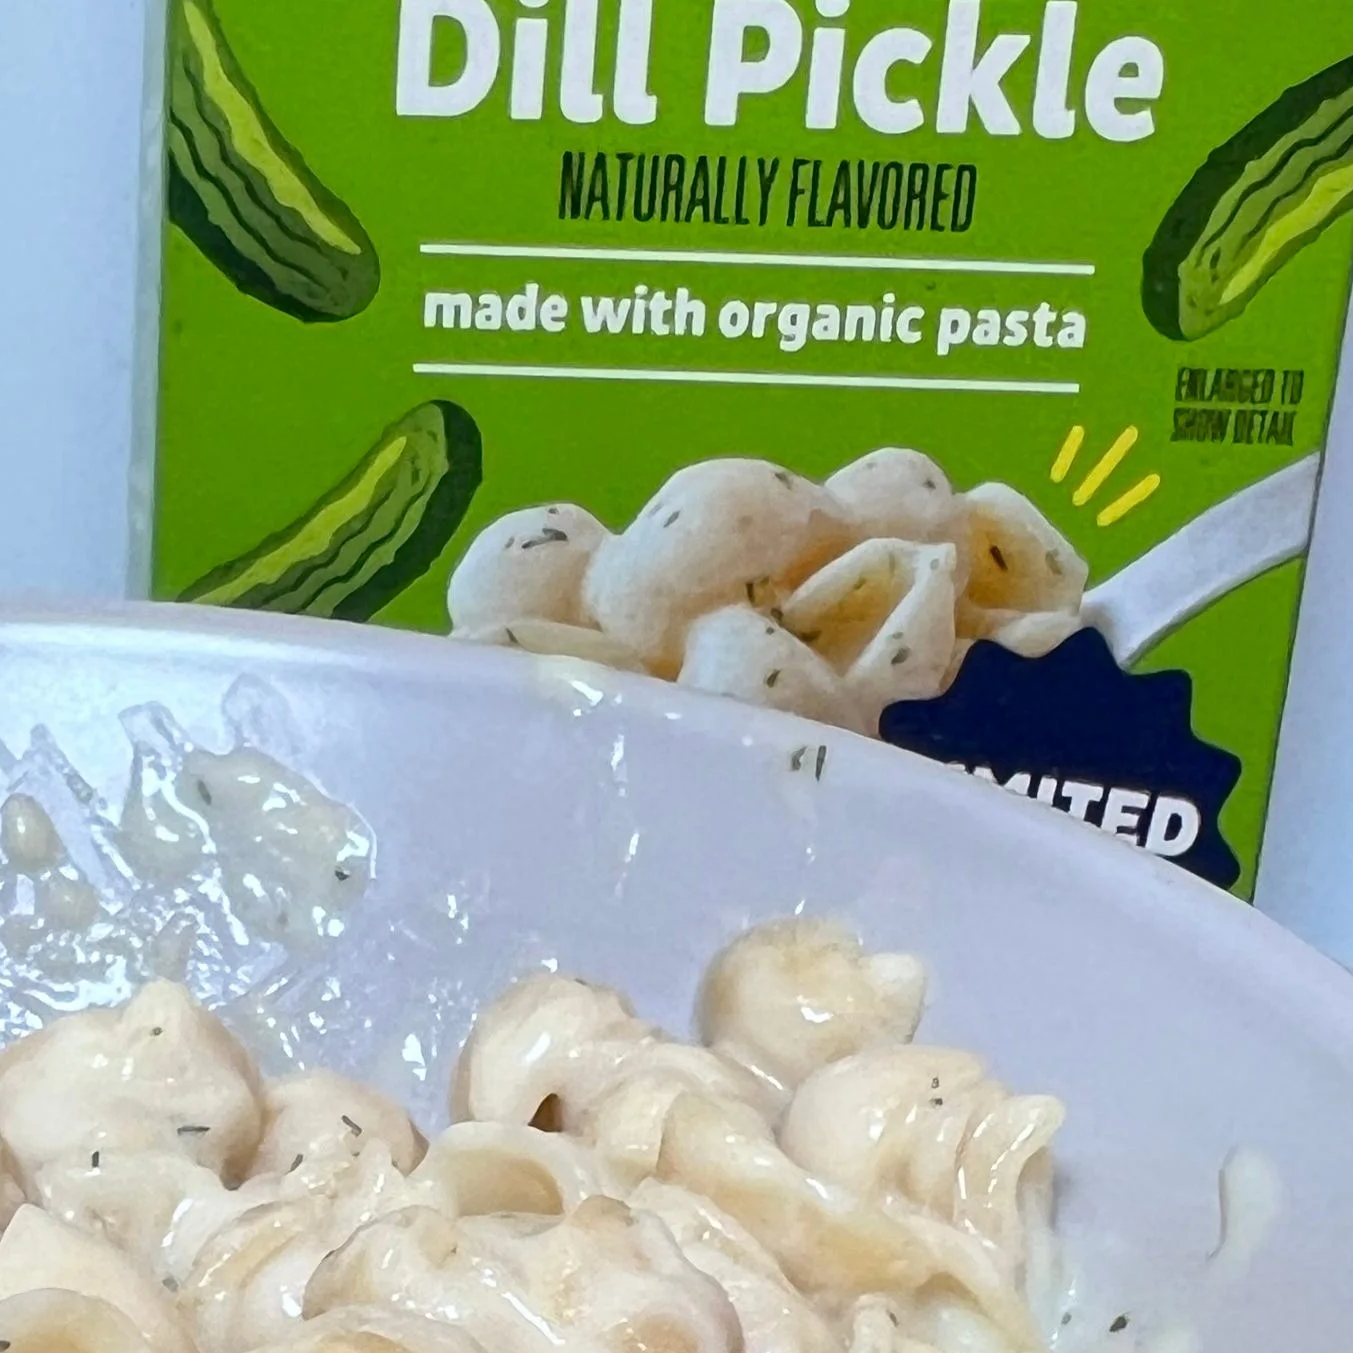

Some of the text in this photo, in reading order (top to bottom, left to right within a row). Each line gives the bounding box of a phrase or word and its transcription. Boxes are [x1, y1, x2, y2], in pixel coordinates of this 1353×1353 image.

[395, 0, 1165, 142] Dill Pickle
[558, 150, 977, 234] NATURALLY FLAVORED
[423, 282, 1087, 356] made with organic pasta
